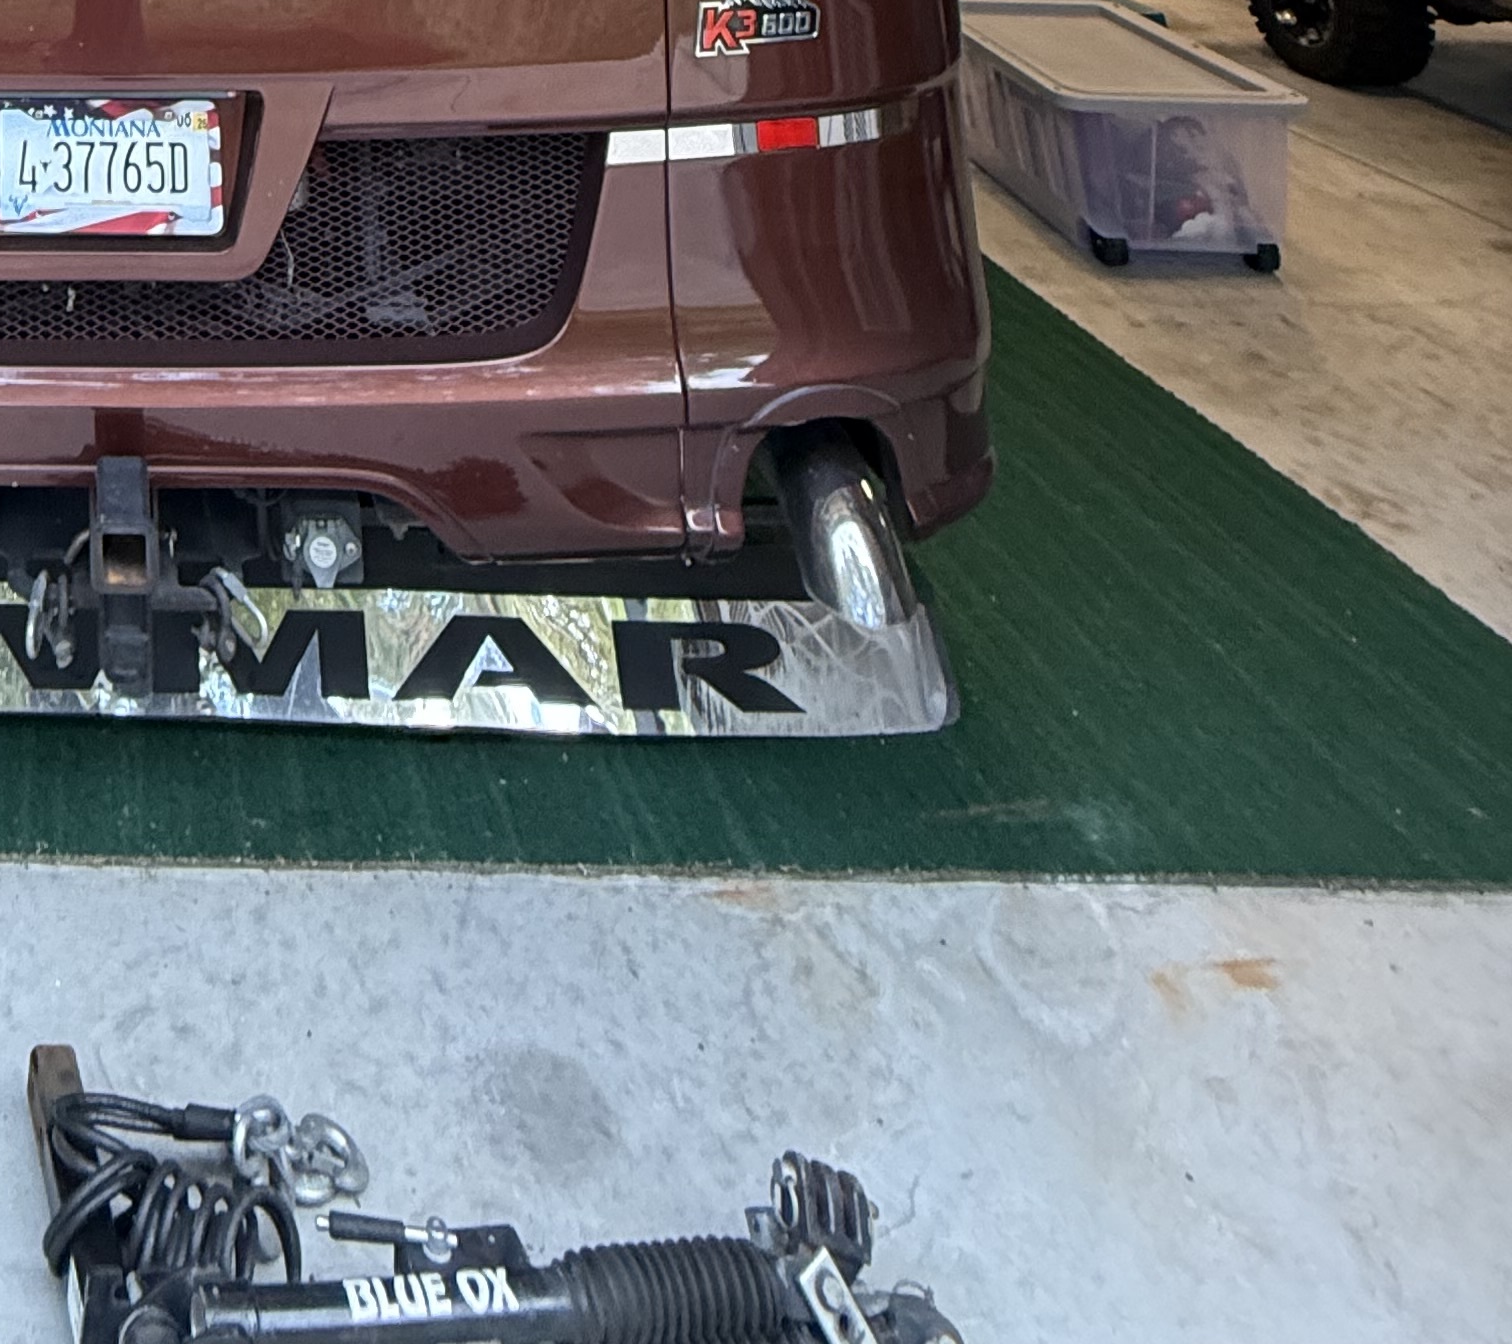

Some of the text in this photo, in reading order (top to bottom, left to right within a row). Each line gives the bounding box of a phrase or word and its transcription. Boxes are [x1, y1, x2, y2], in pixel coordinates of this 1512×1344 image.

[47, 116, 162, 139] MONTANA
[342, 1266, 520, 1321] BLUE OX
